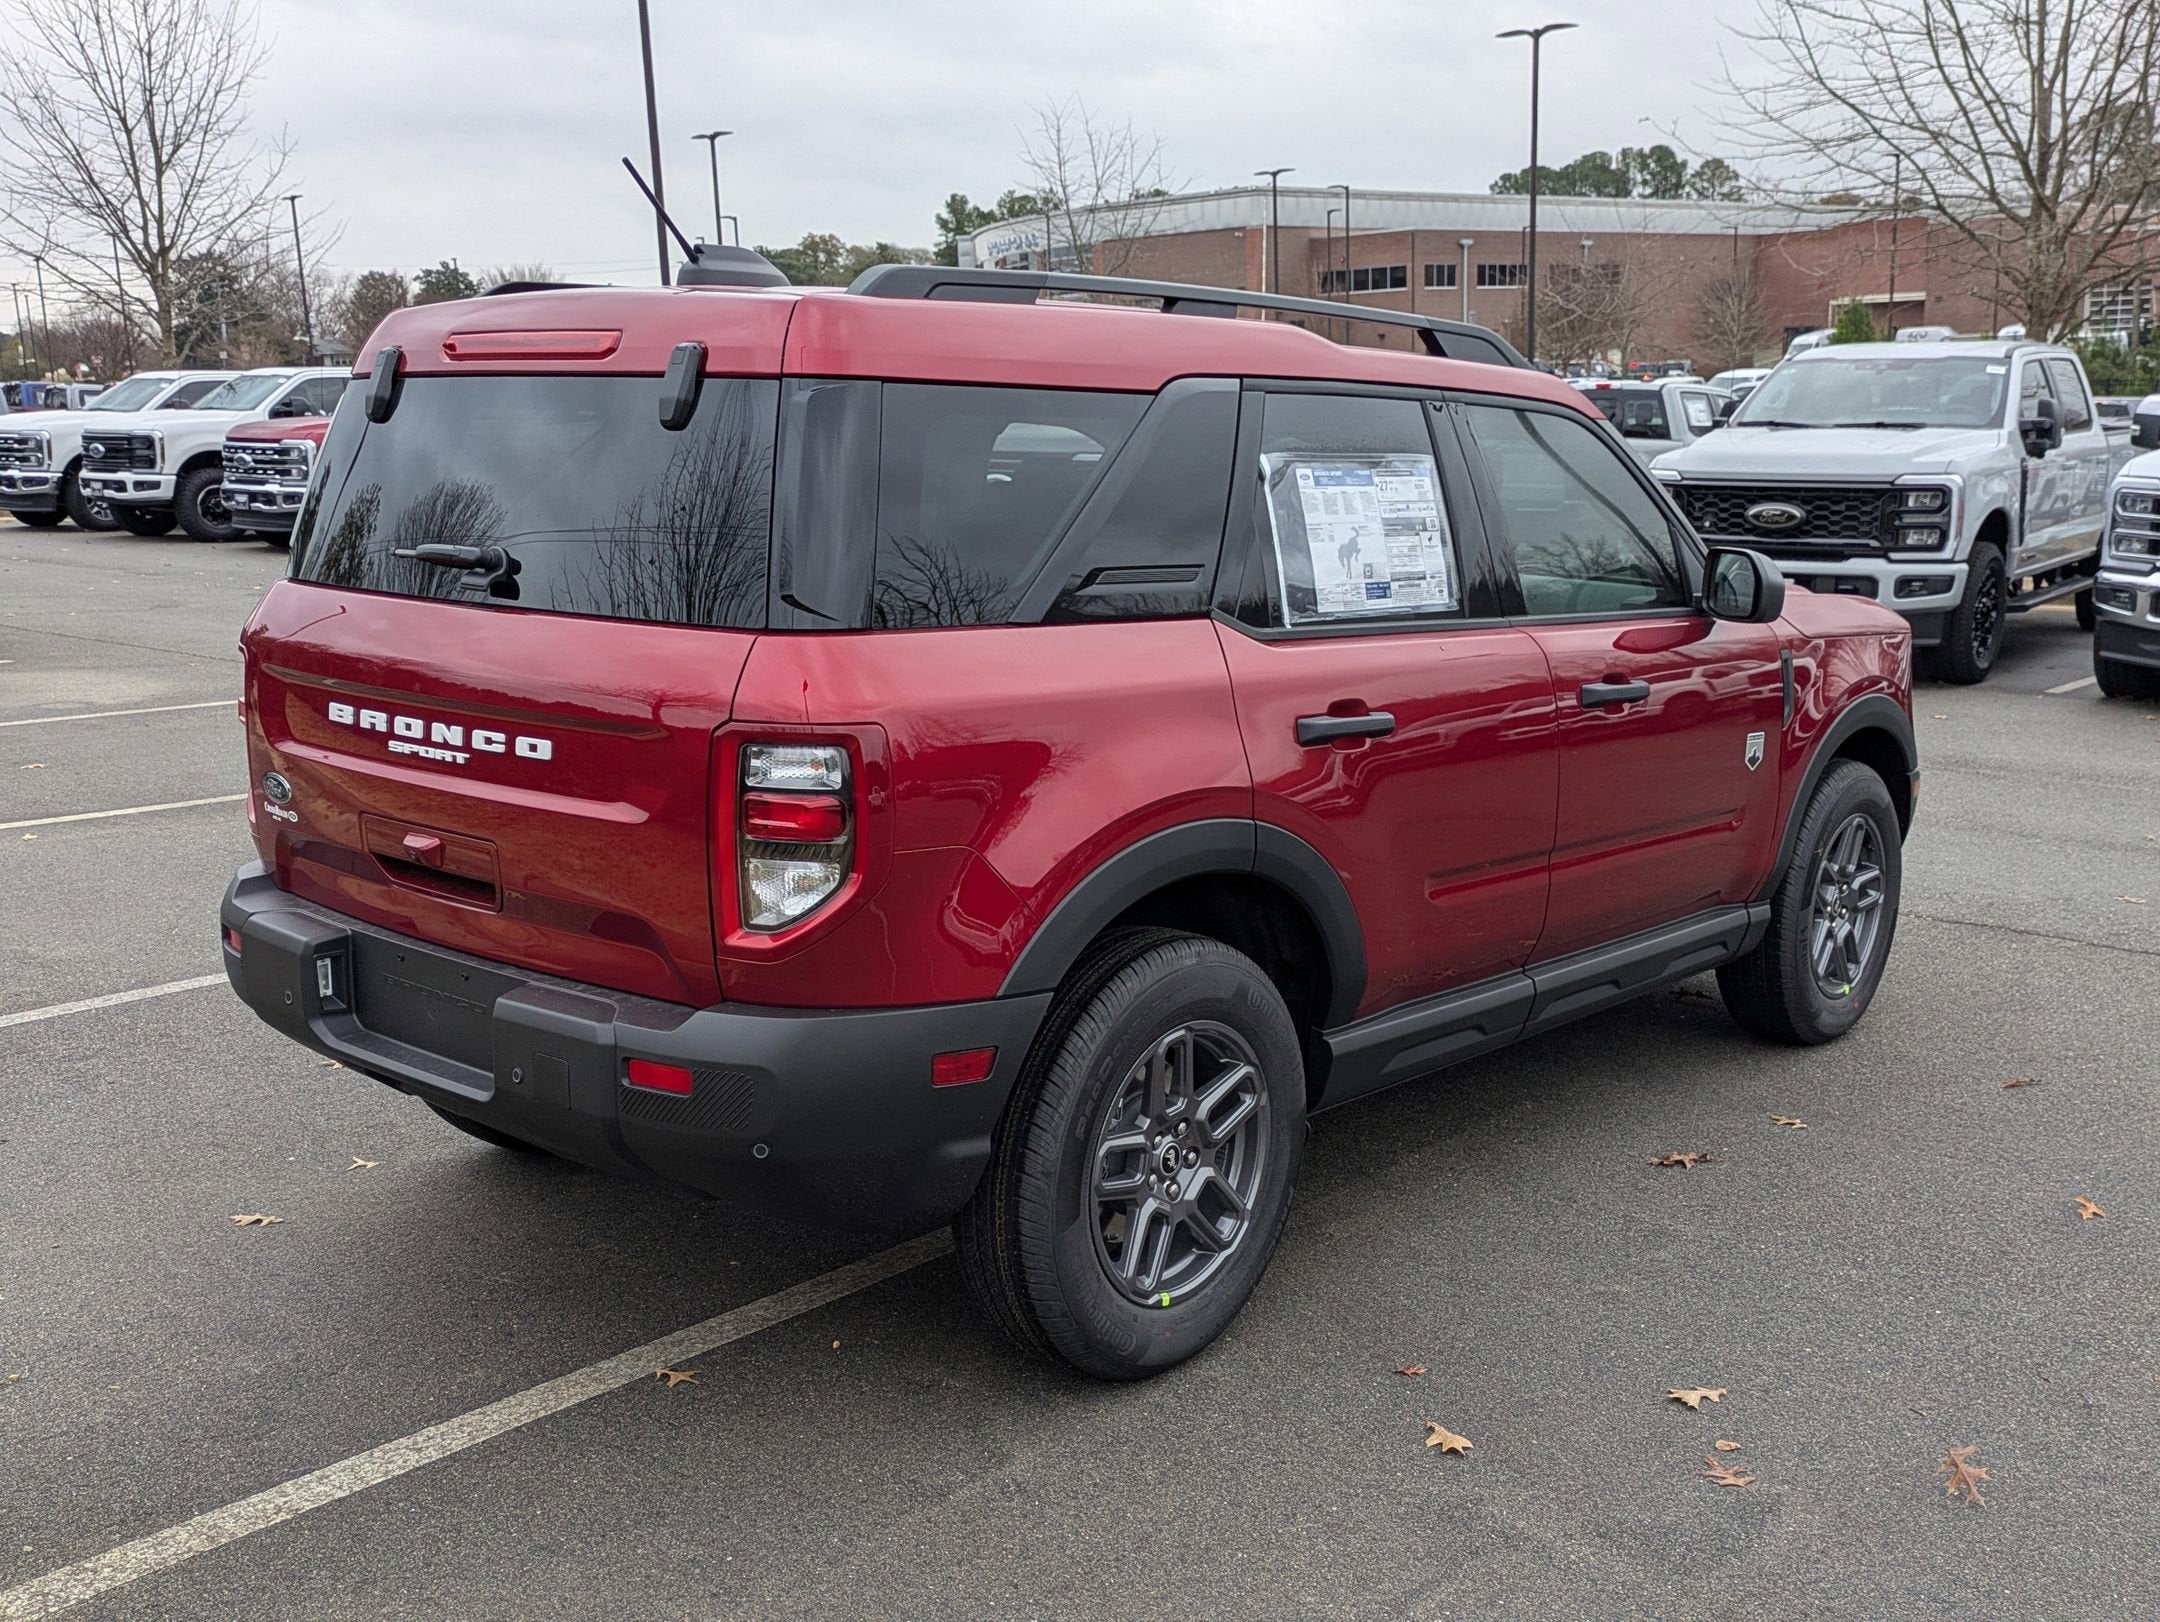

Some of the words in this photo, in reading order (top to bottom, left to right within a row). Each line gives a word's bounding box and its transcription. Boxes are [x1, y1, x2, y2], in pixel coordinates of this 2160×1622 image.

[328, 701, 553, 761] BRONCO
[387, 740, 470, 764] SPORT
[383, 971, 489, 1015] BRONCO
